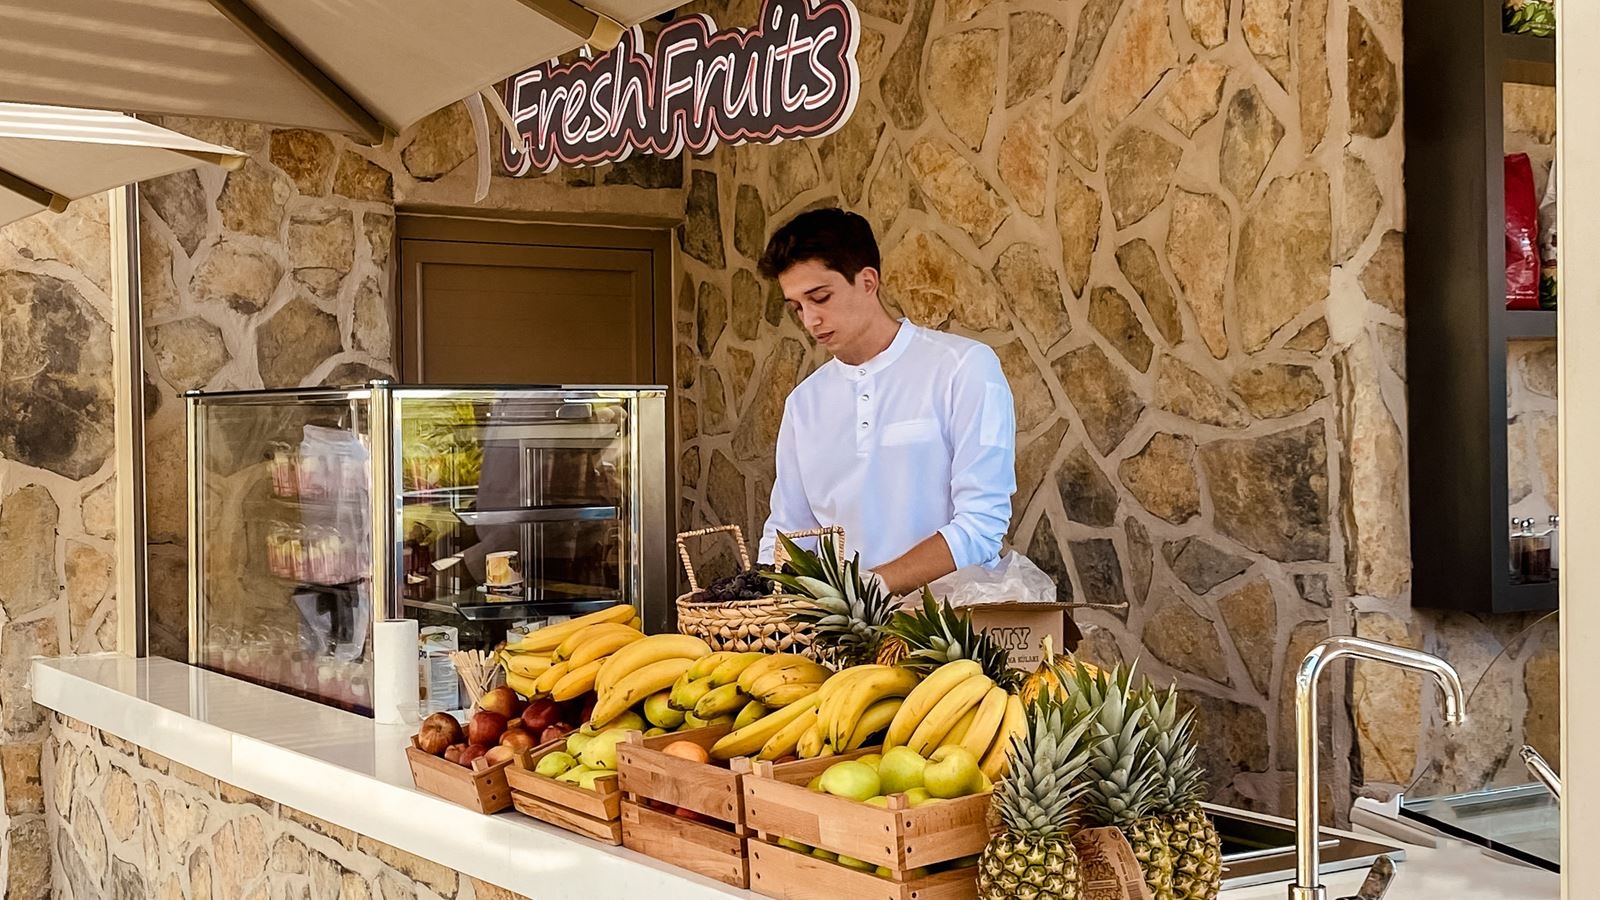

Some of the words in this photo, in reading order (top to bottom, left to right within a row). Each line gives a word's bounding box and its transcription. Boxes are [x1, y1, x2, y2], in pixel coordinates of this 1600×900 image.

[511, 41, 646, 154] Fresh
[659, 4, 837, 134] Fruits
[991, 626, 1031, 650] MY
